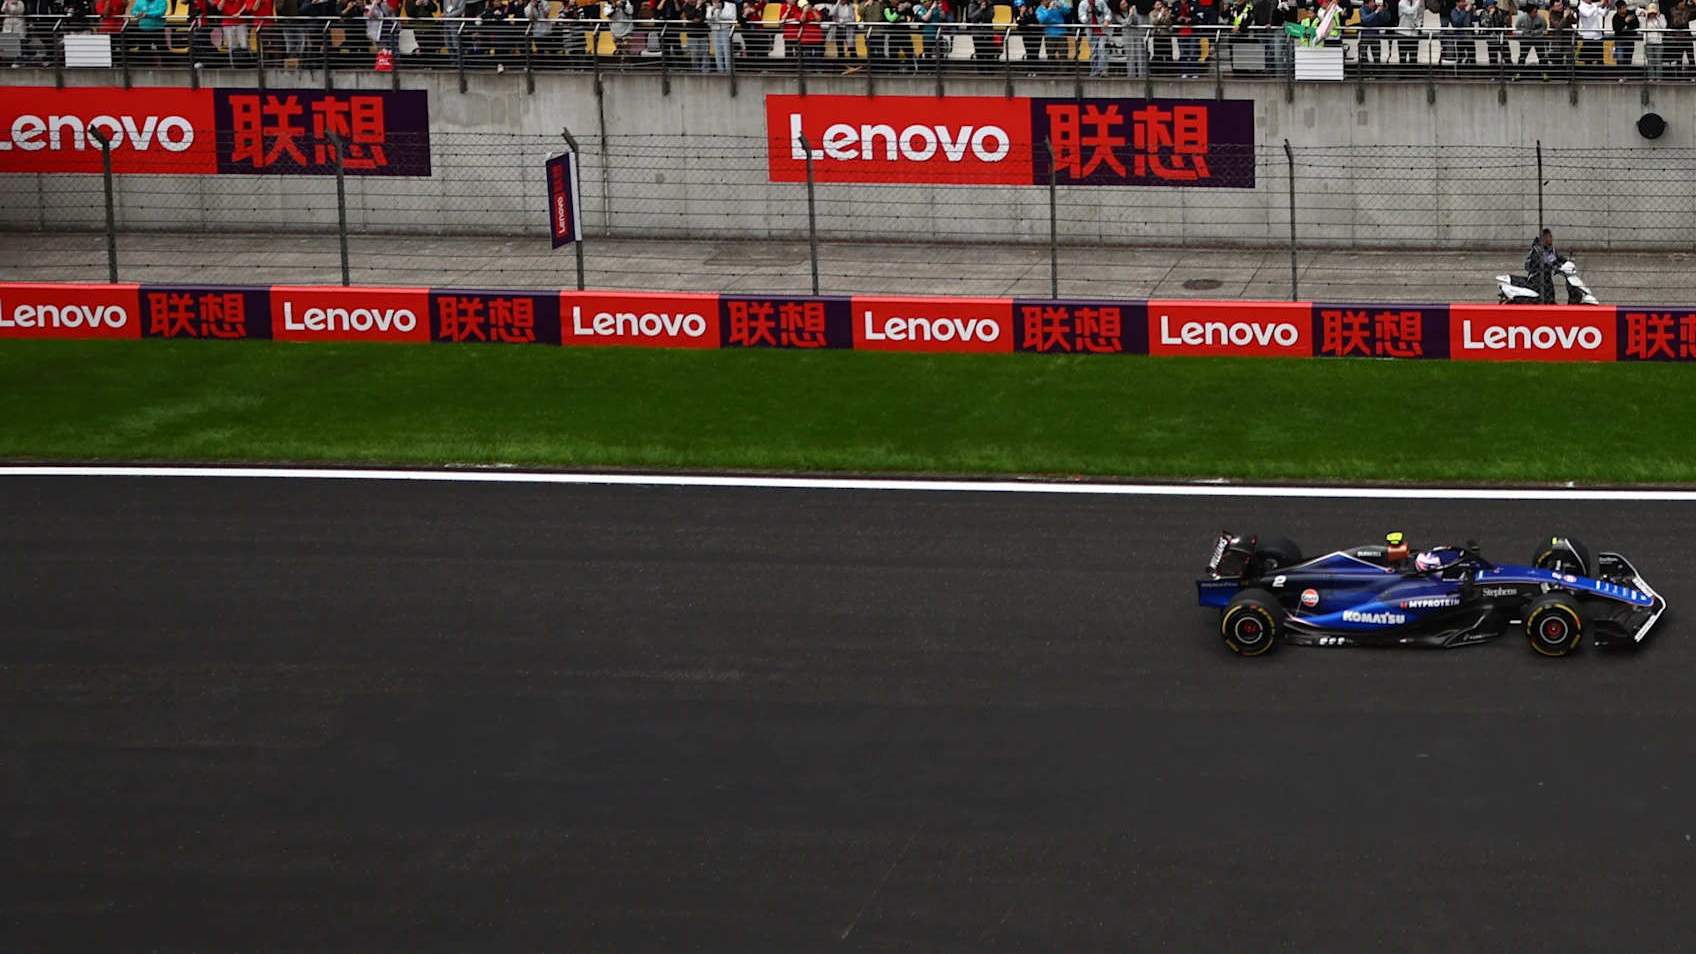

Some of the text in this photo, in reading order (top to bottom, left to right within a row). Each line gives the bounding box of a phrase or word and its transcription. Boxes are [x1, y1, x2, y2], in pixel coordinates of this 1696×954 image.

[228, 94, 388, 170] 联想
[790, 104, 1212, 180] Lenovo 联想
[557, 196, 566, 234] Lenovo
[148, 292, 245, 338] 联想
[284, 297, 535, 342] Lenovo 联想
[573, 301, 826, 347] Lenovo 联想
[865, 306, 1122, 352] Lenovo 联想
[1161, 311, 1422, 357] Lenovo 联想
[1464, 320, 1602, 349] Lenovo
[1272, 575, 1287, 588] 2
[1409, 598, 1460, 608] MYPROTEIN
[1482, 586, 1517, 597] Stephens
[1342, 609, 1405, 625] KOMATSU
